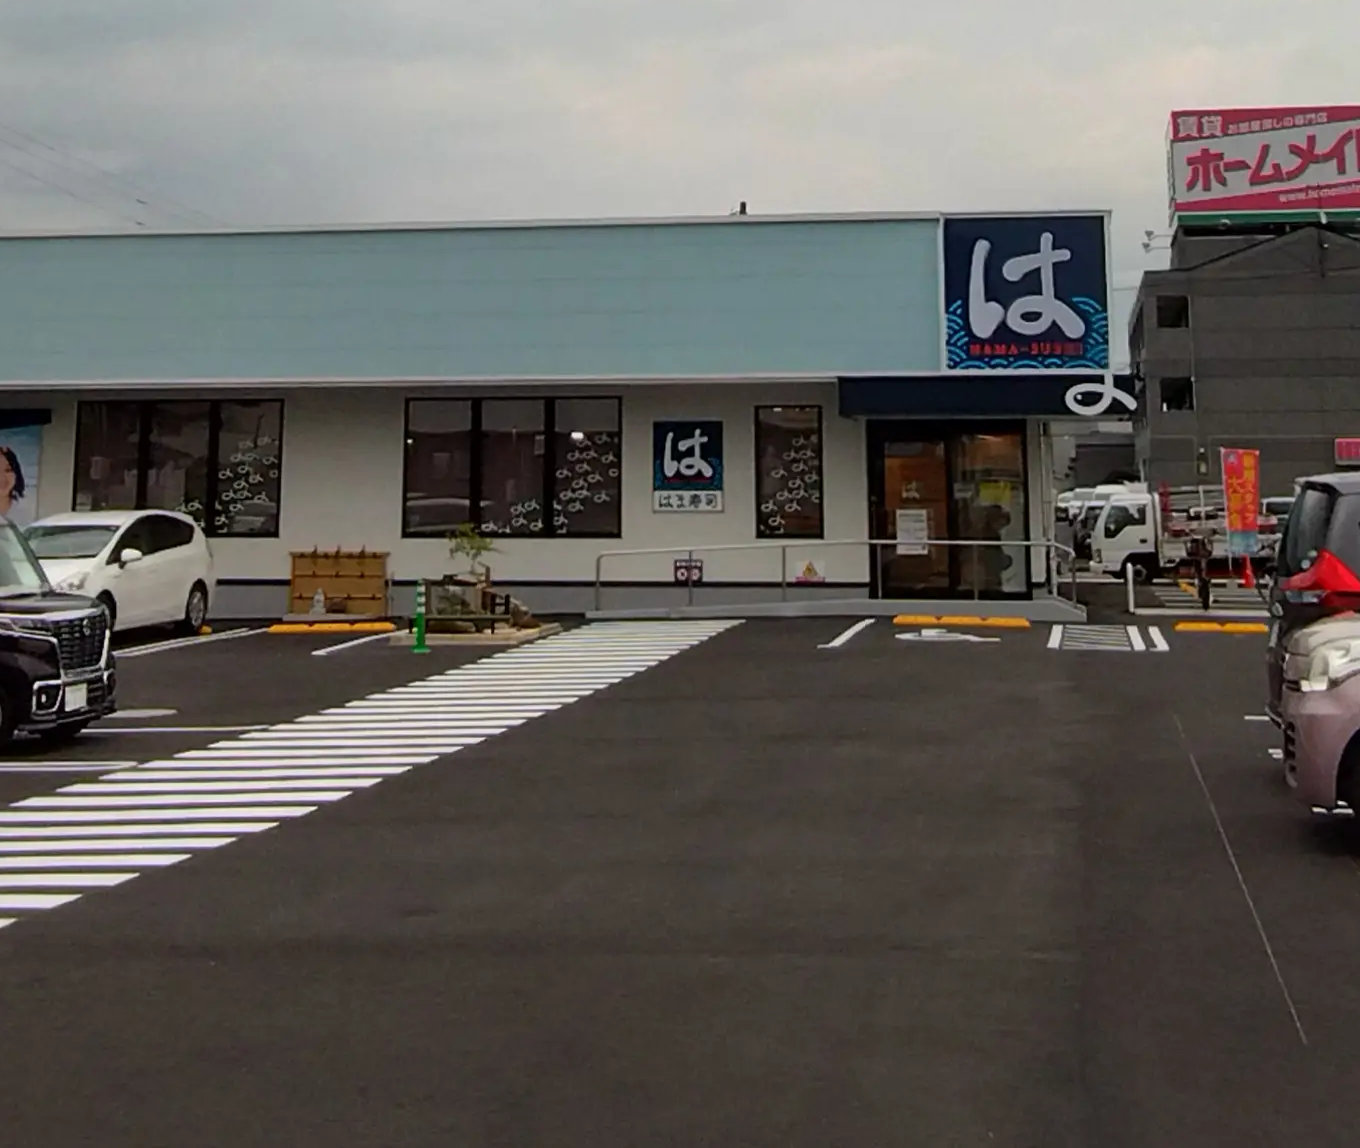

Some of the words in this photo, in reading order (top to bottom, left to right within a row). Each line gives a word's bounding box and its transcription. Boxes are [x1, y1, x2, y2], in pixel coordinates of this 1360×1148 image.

[1177, 115, 1223, 137] 賃貸
[968, 232, 1086, 340] は
[663, 428, 713, 477] は
[658, 493, 718, 510] はま寿司
